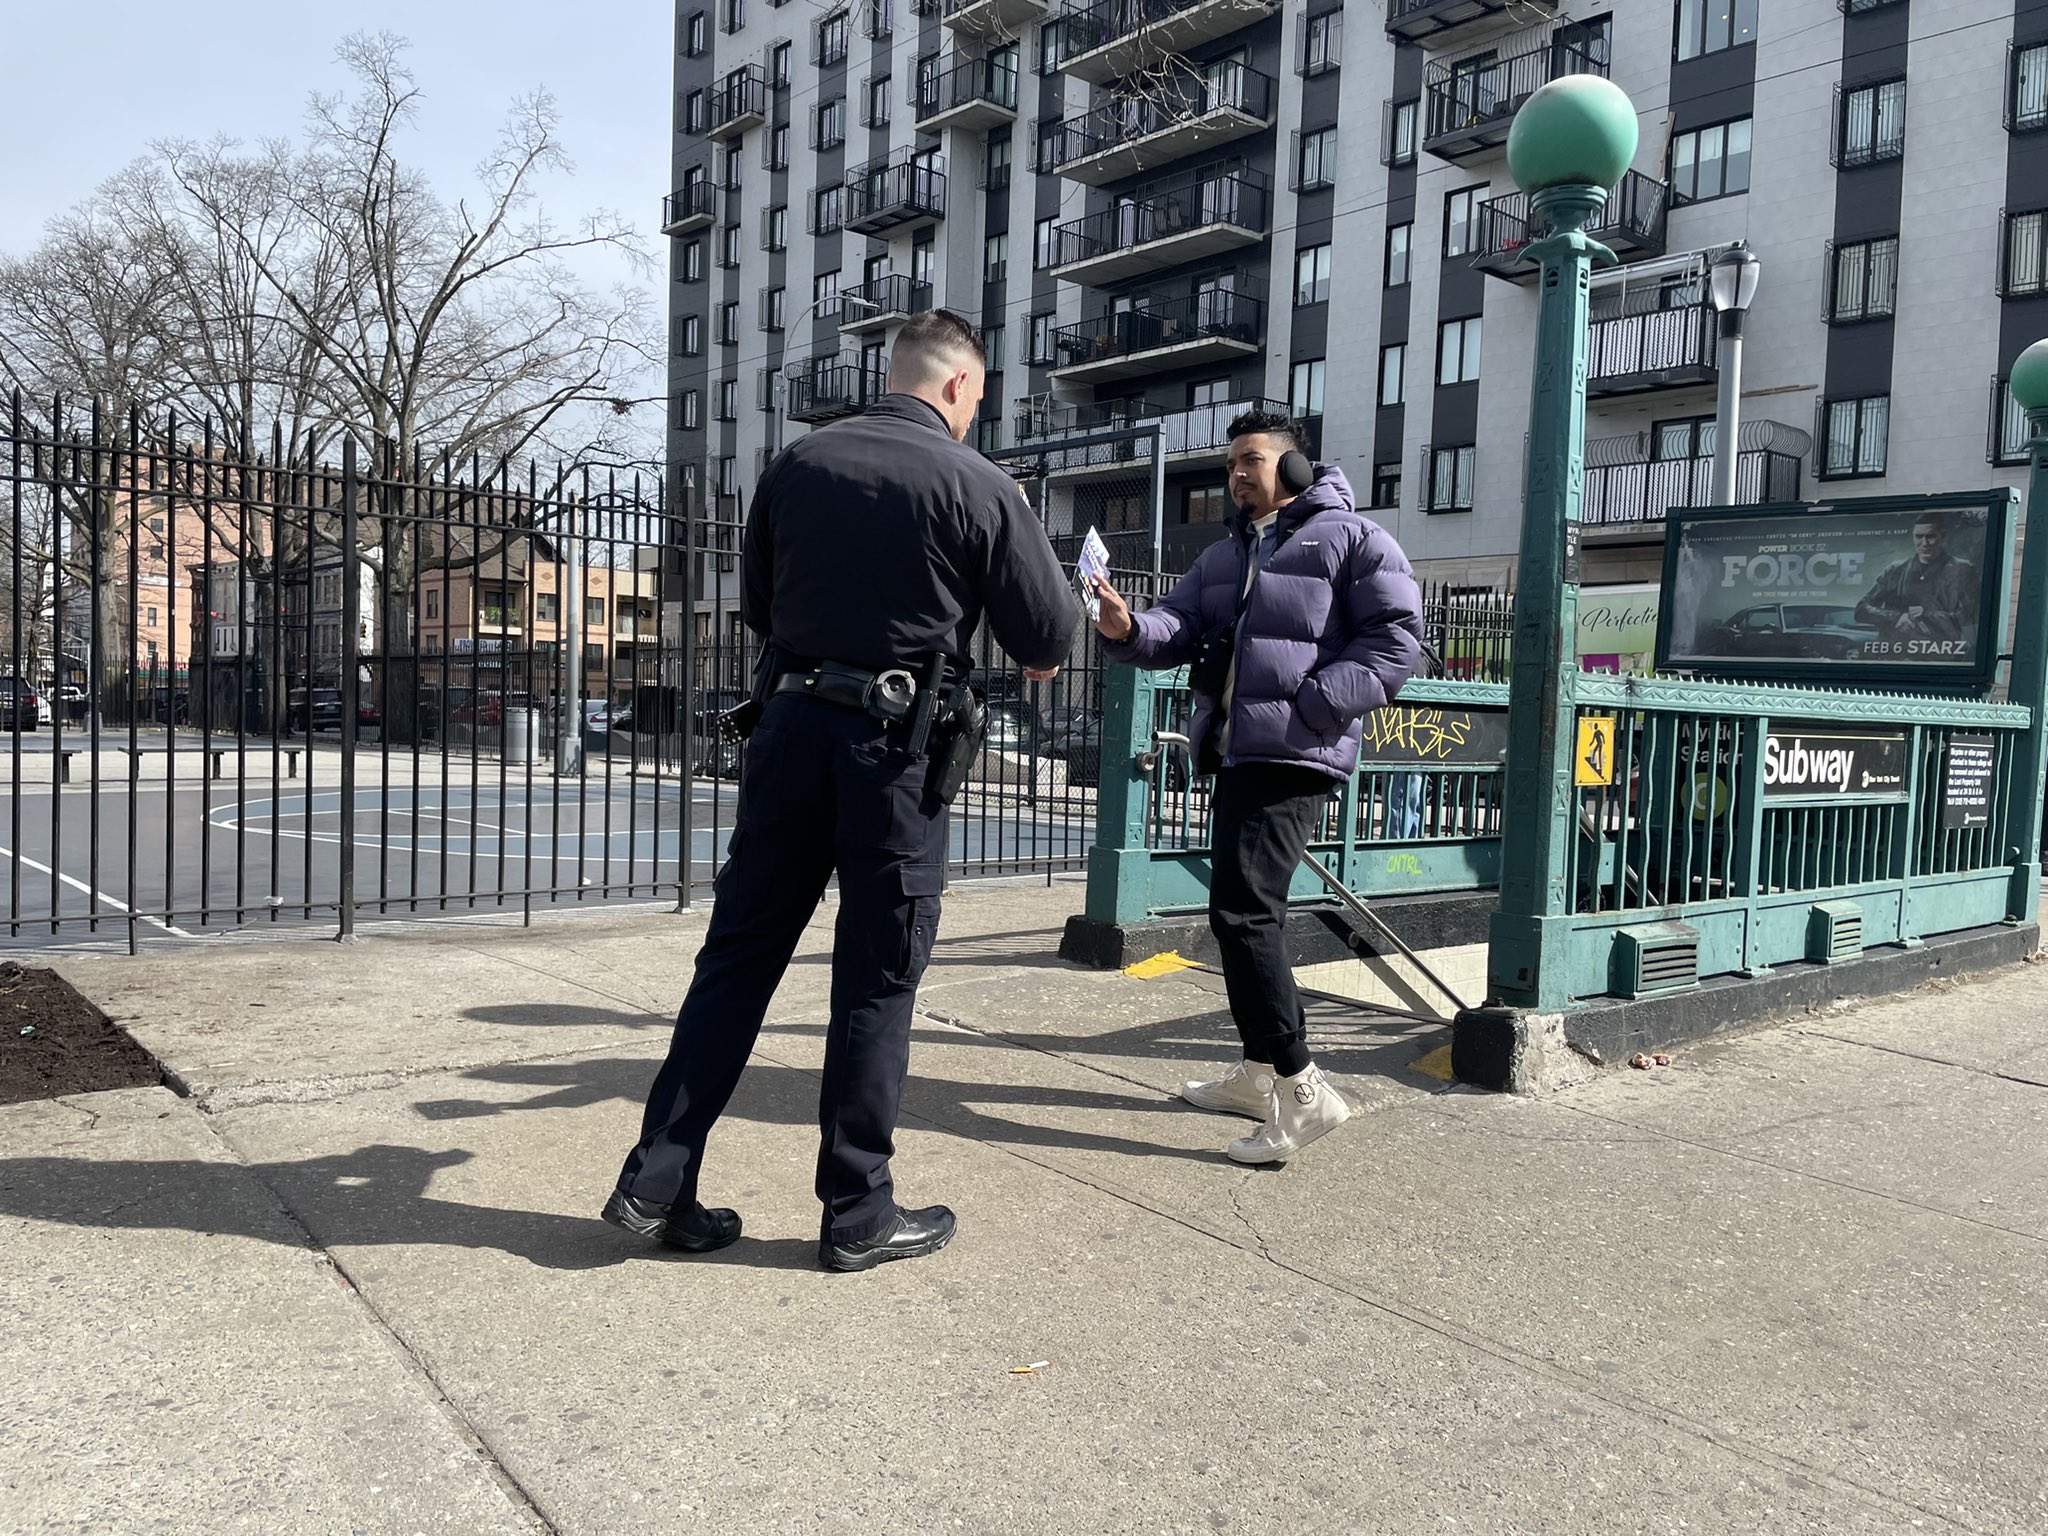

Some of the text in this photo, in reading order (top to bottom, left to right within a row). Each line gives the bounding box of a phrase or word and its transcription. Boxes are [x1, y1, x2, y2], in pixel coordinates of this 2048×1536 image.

[1758, 545, 1788, 553] POWER
[1790, 544, 1814, 552] BOOK
[1720, 552, 1865, 588] FORCE
[1864, 640, 1967, 654] FEB 6 STARZ
[1682, 723, 1744, 742] Mytl-
[1681, 746, 1743, 765] Saion
[1763, 737, 1854, 792] Subway
